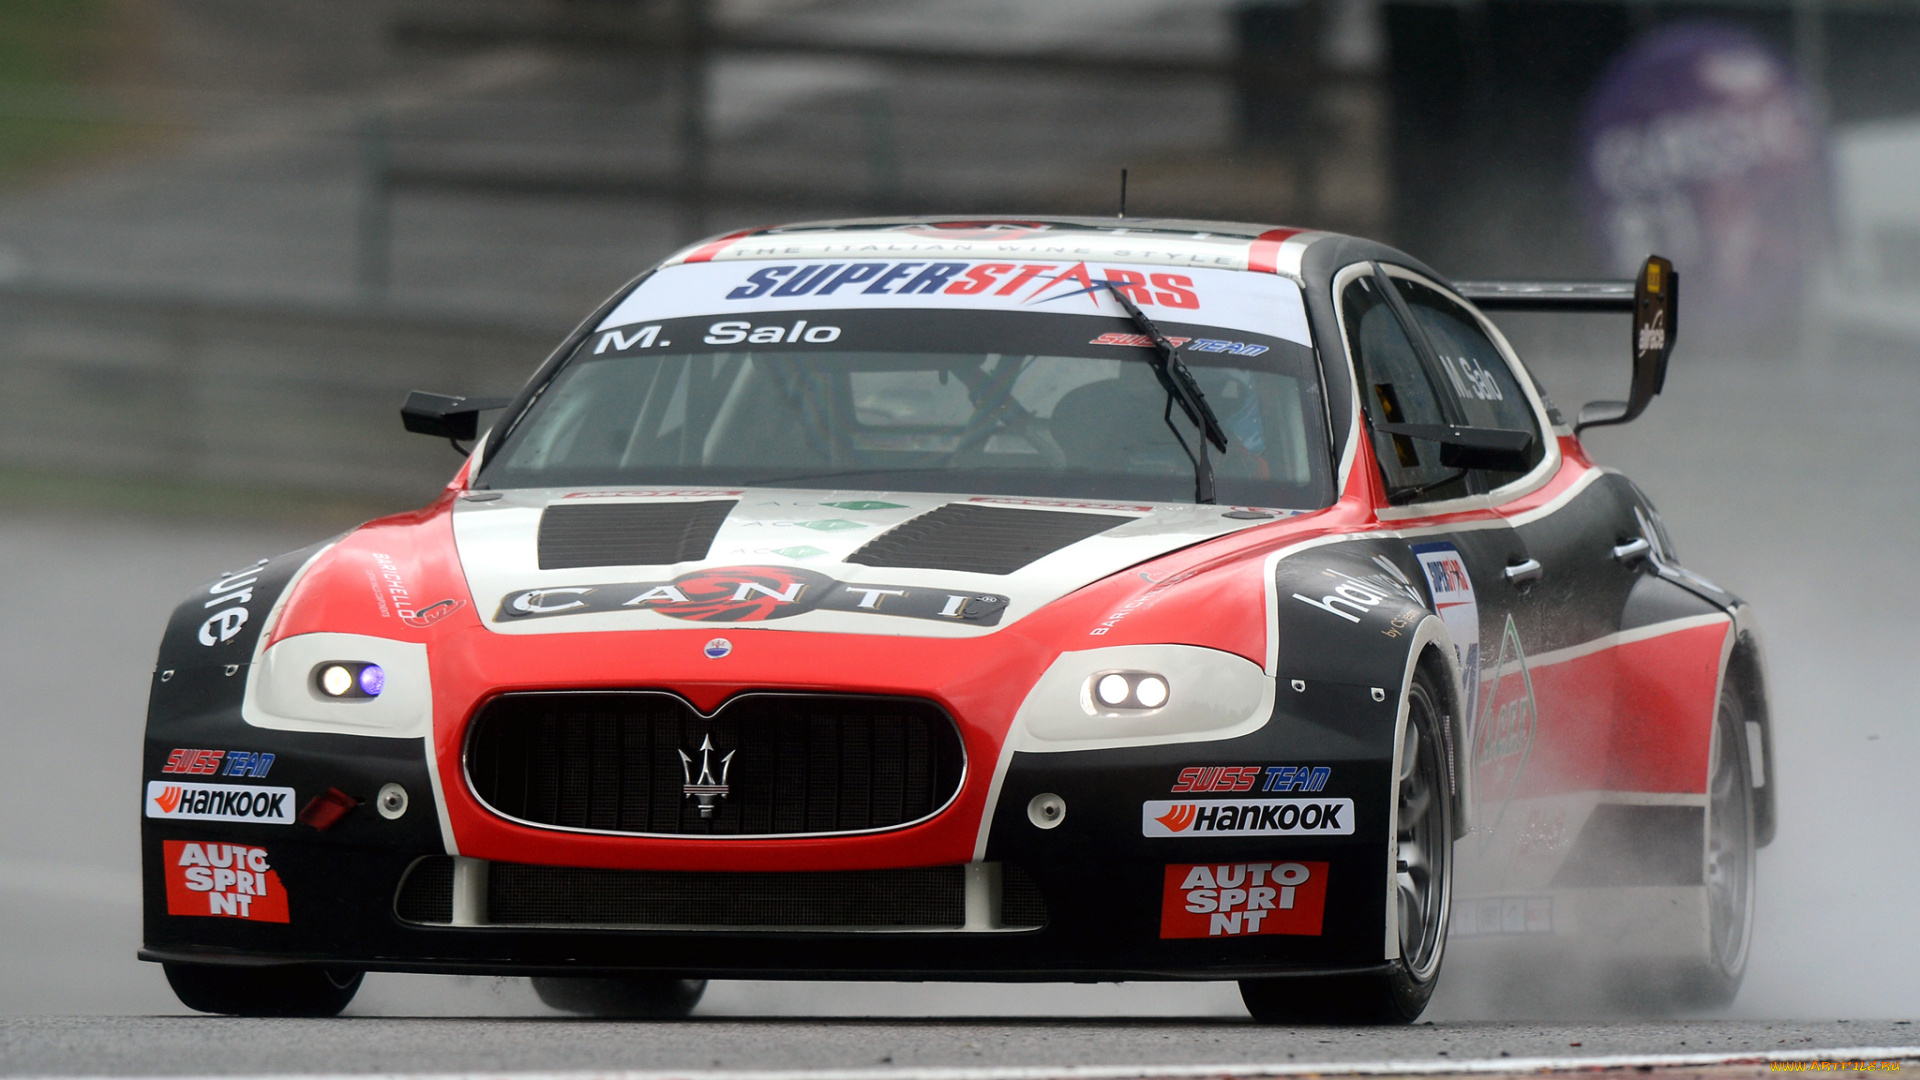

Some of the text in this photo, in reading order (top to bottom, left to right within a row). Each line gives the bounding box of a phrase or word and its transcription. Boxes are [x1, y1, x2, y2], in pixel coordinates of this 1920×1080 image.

[735, 243, 1236, 267] THE ITALIAN WINE STYLE
[726, 260, 1200, 310] SUPERSTARS
[594, 319, 842, 355] M. Salo
[1188, 337, 1270, 357] TEAM
[372, 552, 417, 619] BARICHELLO
[199, 563, 266, 647] ure
[162, 748, 275, 778] SWISS TEAM
[1171, 766, 1331, 792] SWISS TEAM
[178, 843, 271, 873] AUTO
[185, 867, 267, 897] SPRI
[1180, 862, 1311, 890] AUTO
[209, 891, 253, 918] NT
[1185, 886, 1296, 914] SPRI
[1209, 909, 1268, 936] NT
